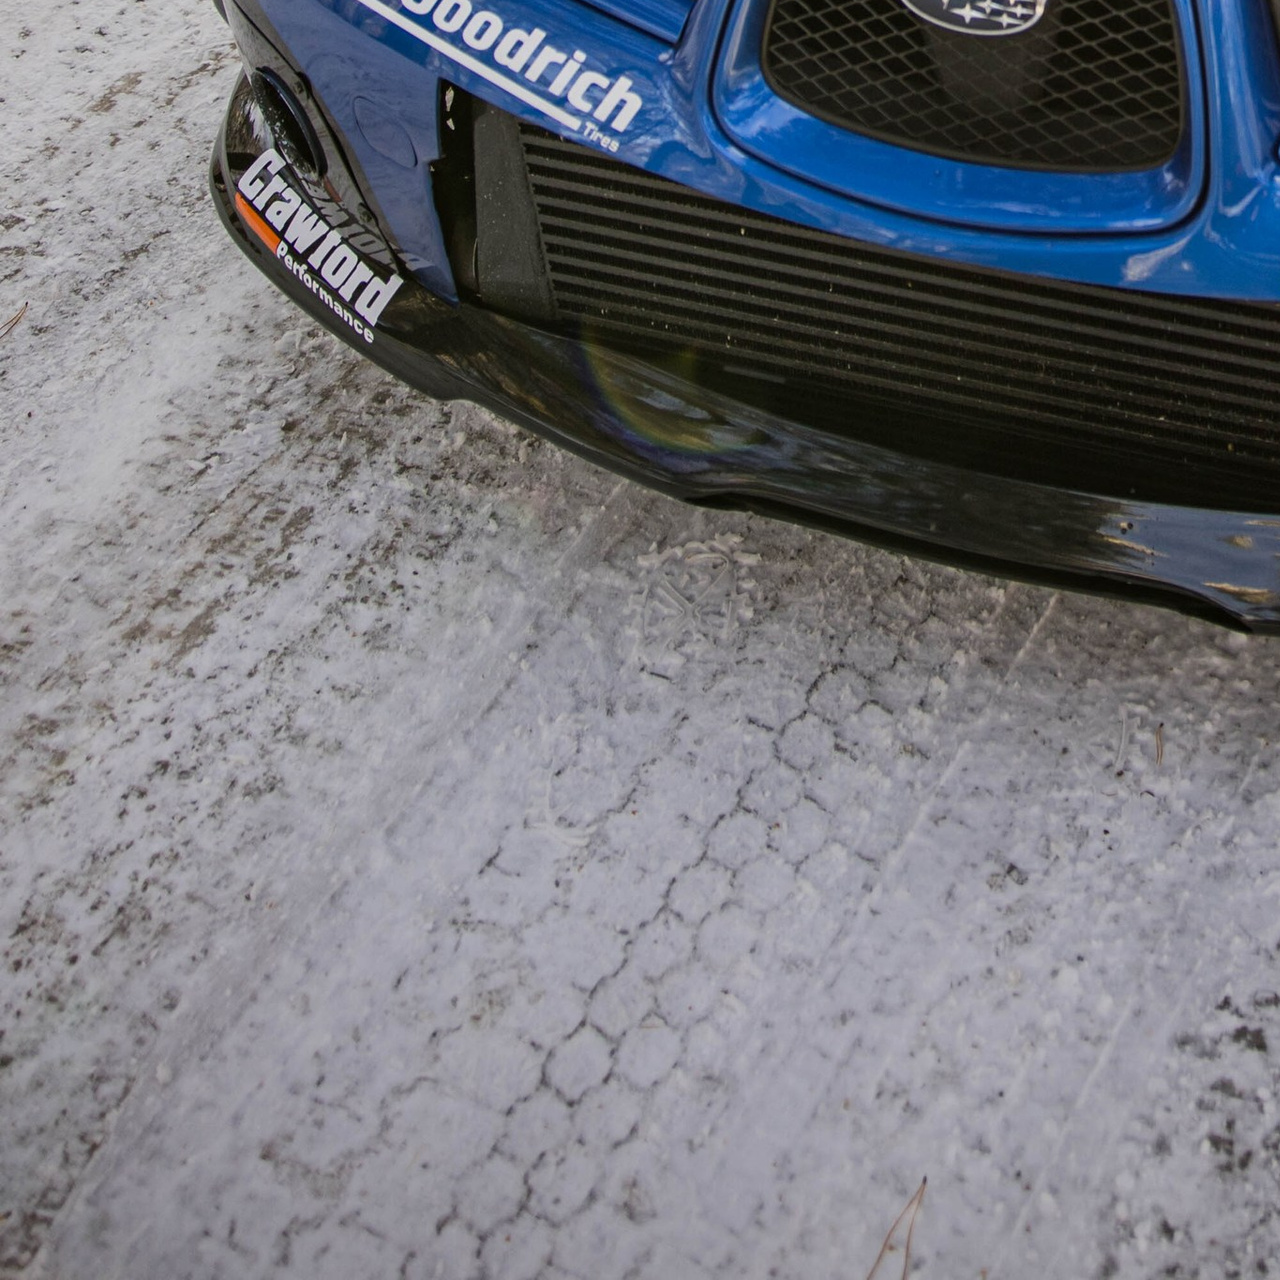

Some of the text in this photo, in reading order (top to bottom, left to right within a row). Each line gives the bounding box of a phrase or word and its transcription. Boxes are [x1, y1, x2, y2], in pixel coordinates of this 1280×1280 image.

[583, 122, 620, 153] Tires
[238, 148, 404, 327] Crawford
[276, 240, 375, 344] Performance
